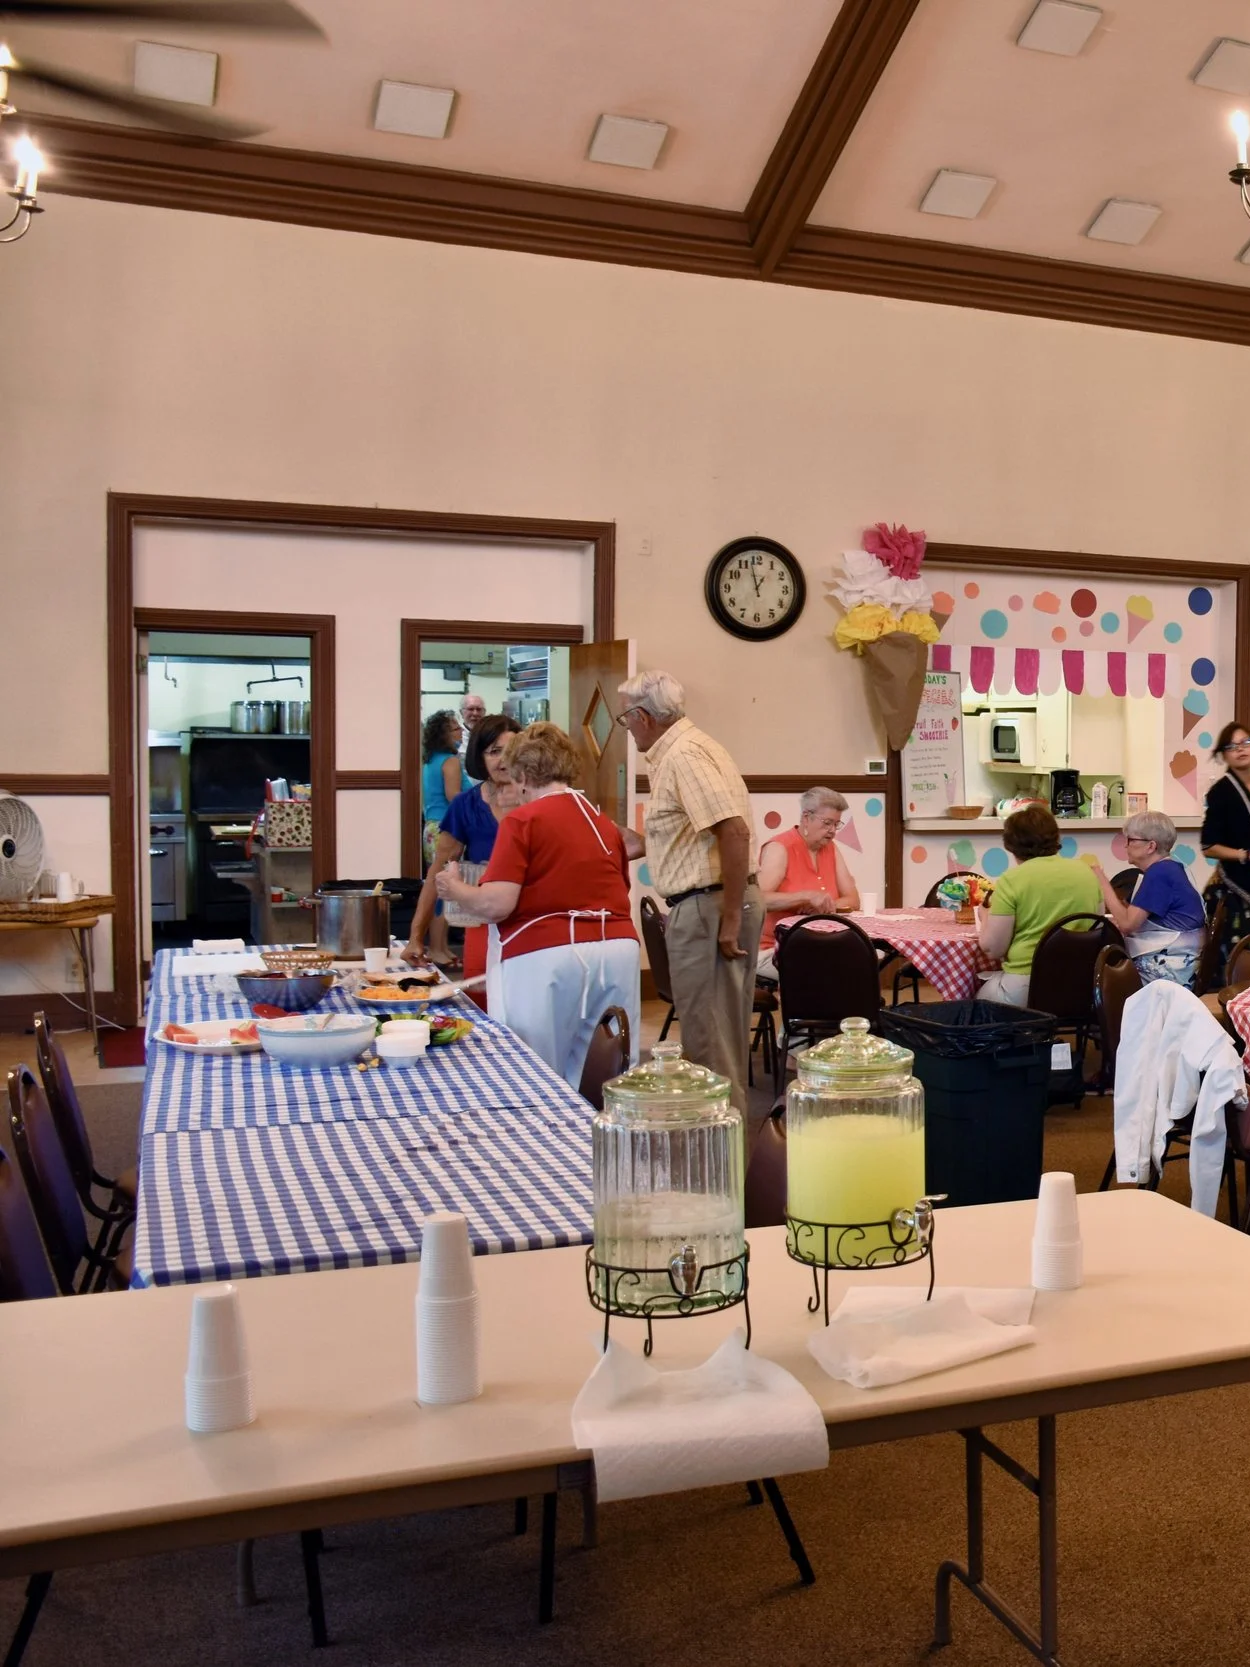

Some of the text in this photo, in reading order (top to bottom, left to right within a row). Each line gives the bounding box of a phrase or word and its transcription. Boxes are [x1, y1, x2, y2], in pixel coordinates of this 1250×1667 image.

[738, 560, 749, 569] 11
[751, 555, 763, 565] 12
[769, 561, 775, 570] 1
[729, 570, 741, 580] 10
[778, 571, 785, 581] 2
[724, 584, 731, 593] 9
[782, 585, 788, 595] 3
[728, 597, 736, 607] 8
[777, 598, 784, 608] 4
[739, 608, 746, 618] 7
[753, 612, 761, 623] 6
[768, 608, 775, 618] 5
[923, 675, 947, 684] ODAY'S
